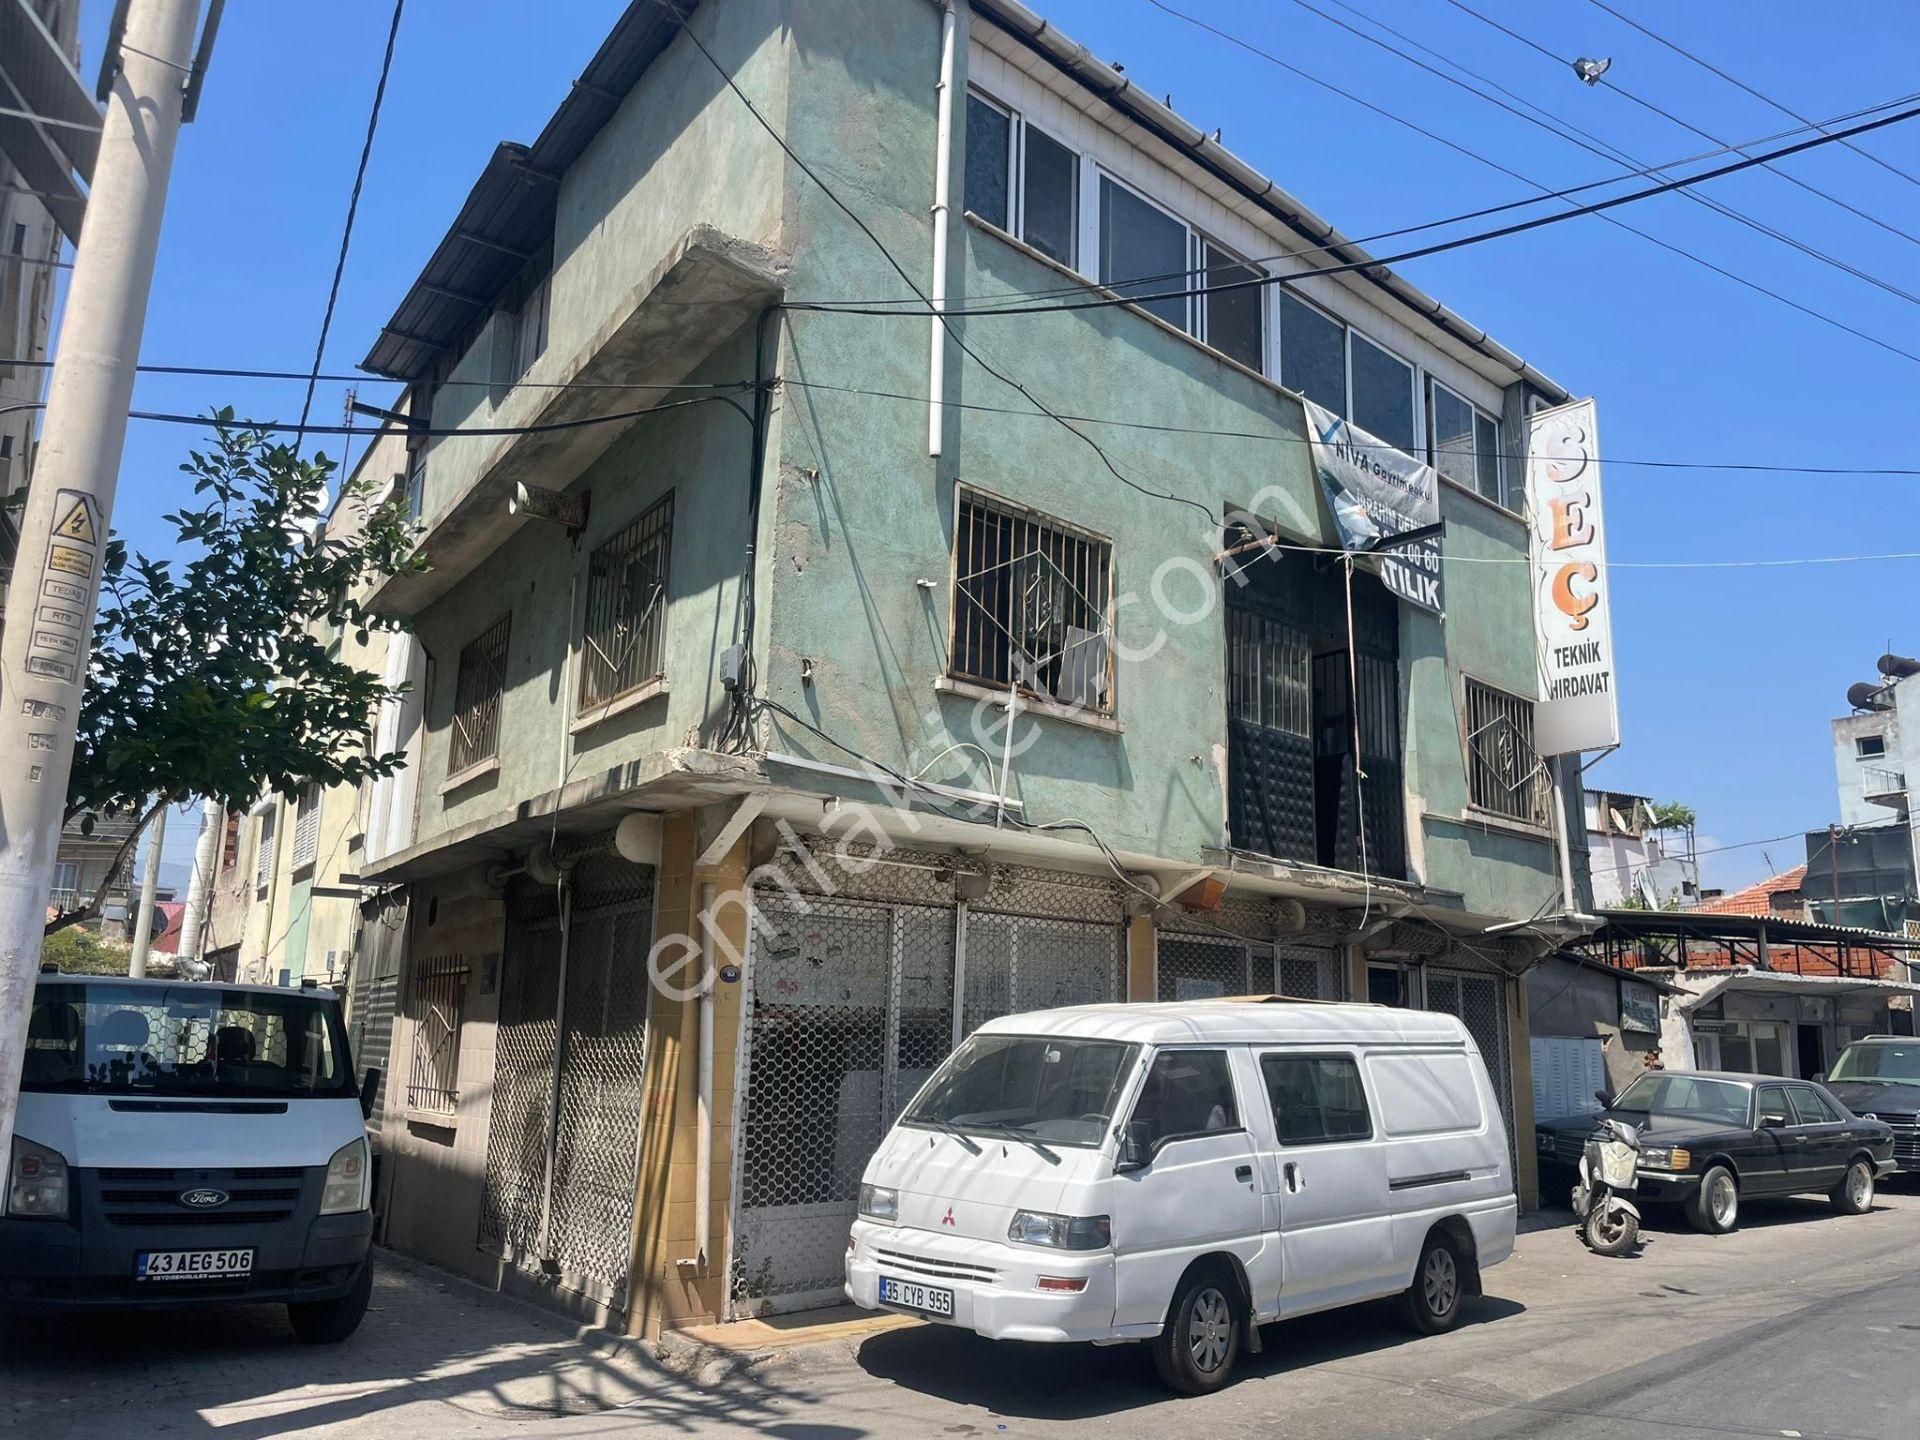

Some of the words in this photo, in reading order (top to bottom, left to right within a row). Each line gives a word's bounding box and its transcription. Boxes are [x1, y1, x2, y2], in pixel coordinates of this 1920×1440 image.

[1336, 440, 1369, 473] NİVA
[52, 585, 82, 600] TEDAŞ
[1554, 638, 1602, 669] TEKNİK
[1551, 671, 1610, 700] HIRDAVAT
[190, 1191, 219, 1203] Ford
[149, 1254, 173, 1272] 43
[176, 1253, 213, 1272] AEG
[216, 1251, 251, 1270] 506
[886, 1281, 899, 1301] 35
[903, 1285, 924, 1306] CYB
[928, 1290, 950, 1312] 955
